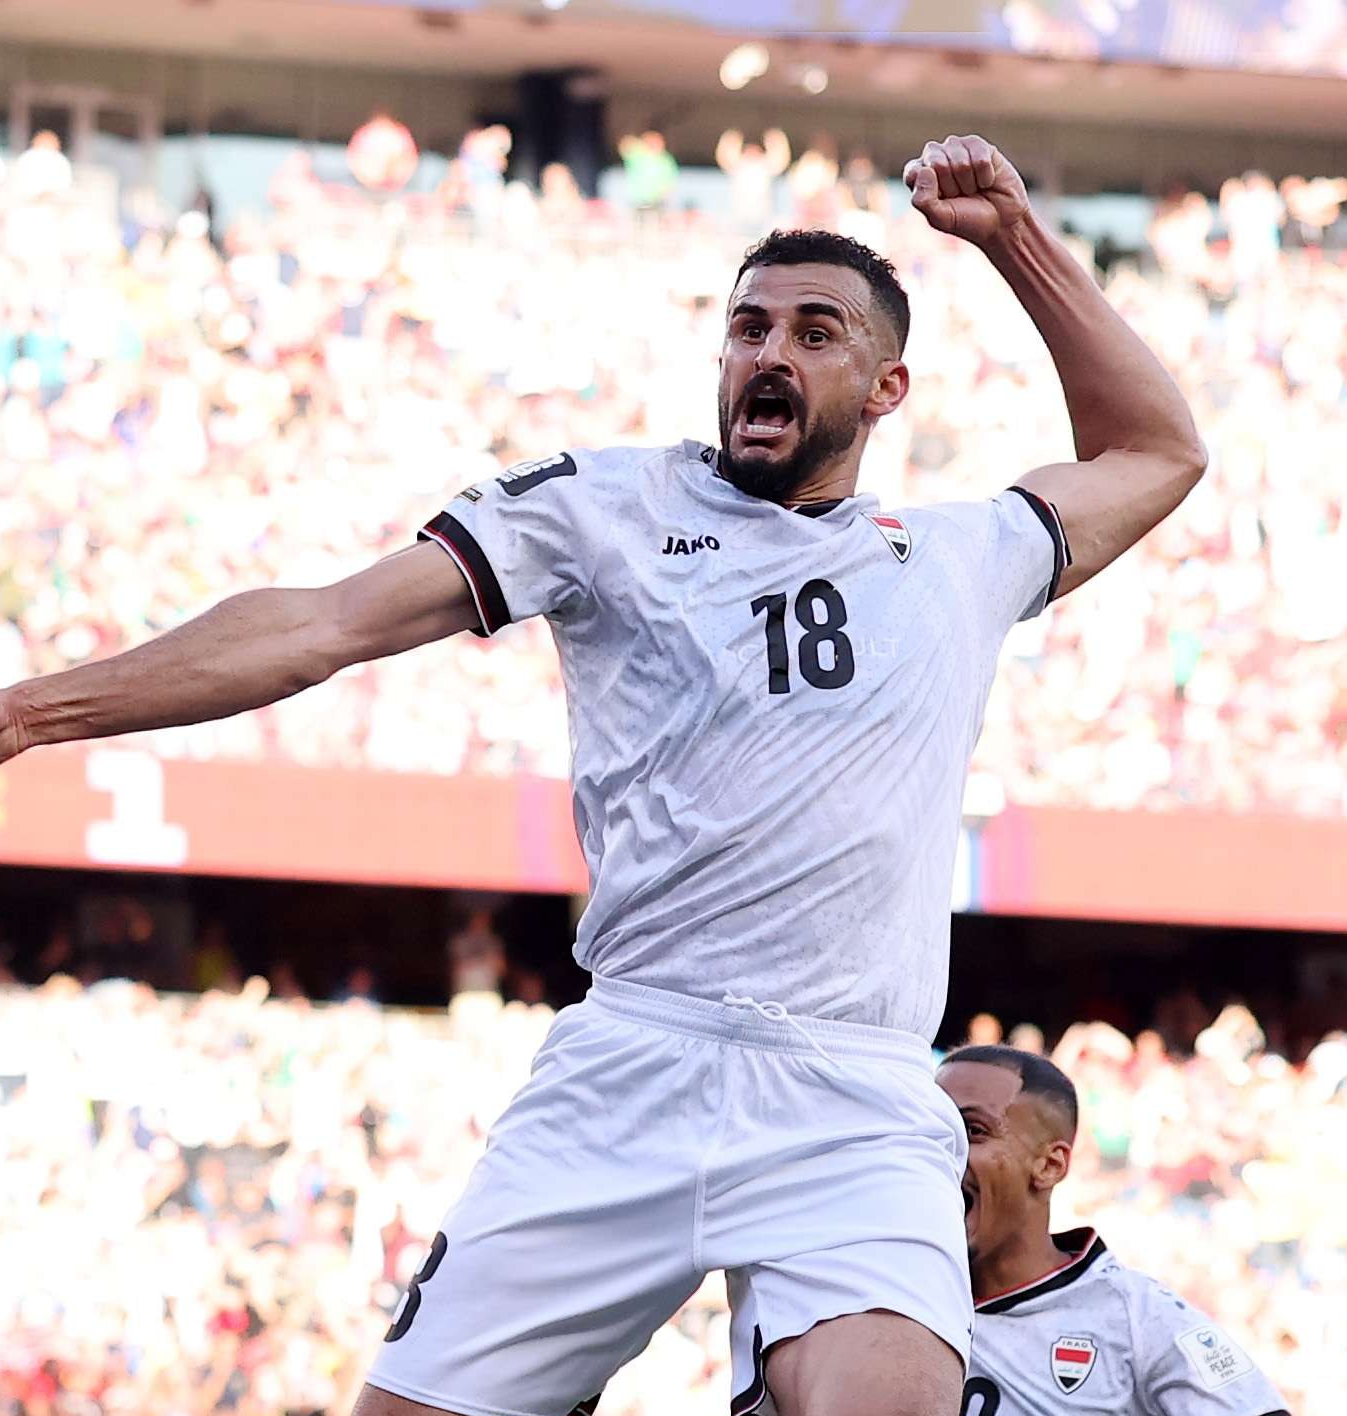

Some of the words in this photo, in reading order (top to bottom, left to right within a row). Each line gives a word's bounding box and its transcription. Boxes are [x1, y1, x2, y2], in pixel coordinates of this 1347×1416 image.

[662, 535, 720, 556] JAKO
[750, 578, 855, 694] 18
[86, 749, 188, 866] 1
[1062, 1340, 1089, 1349] IRAQ
